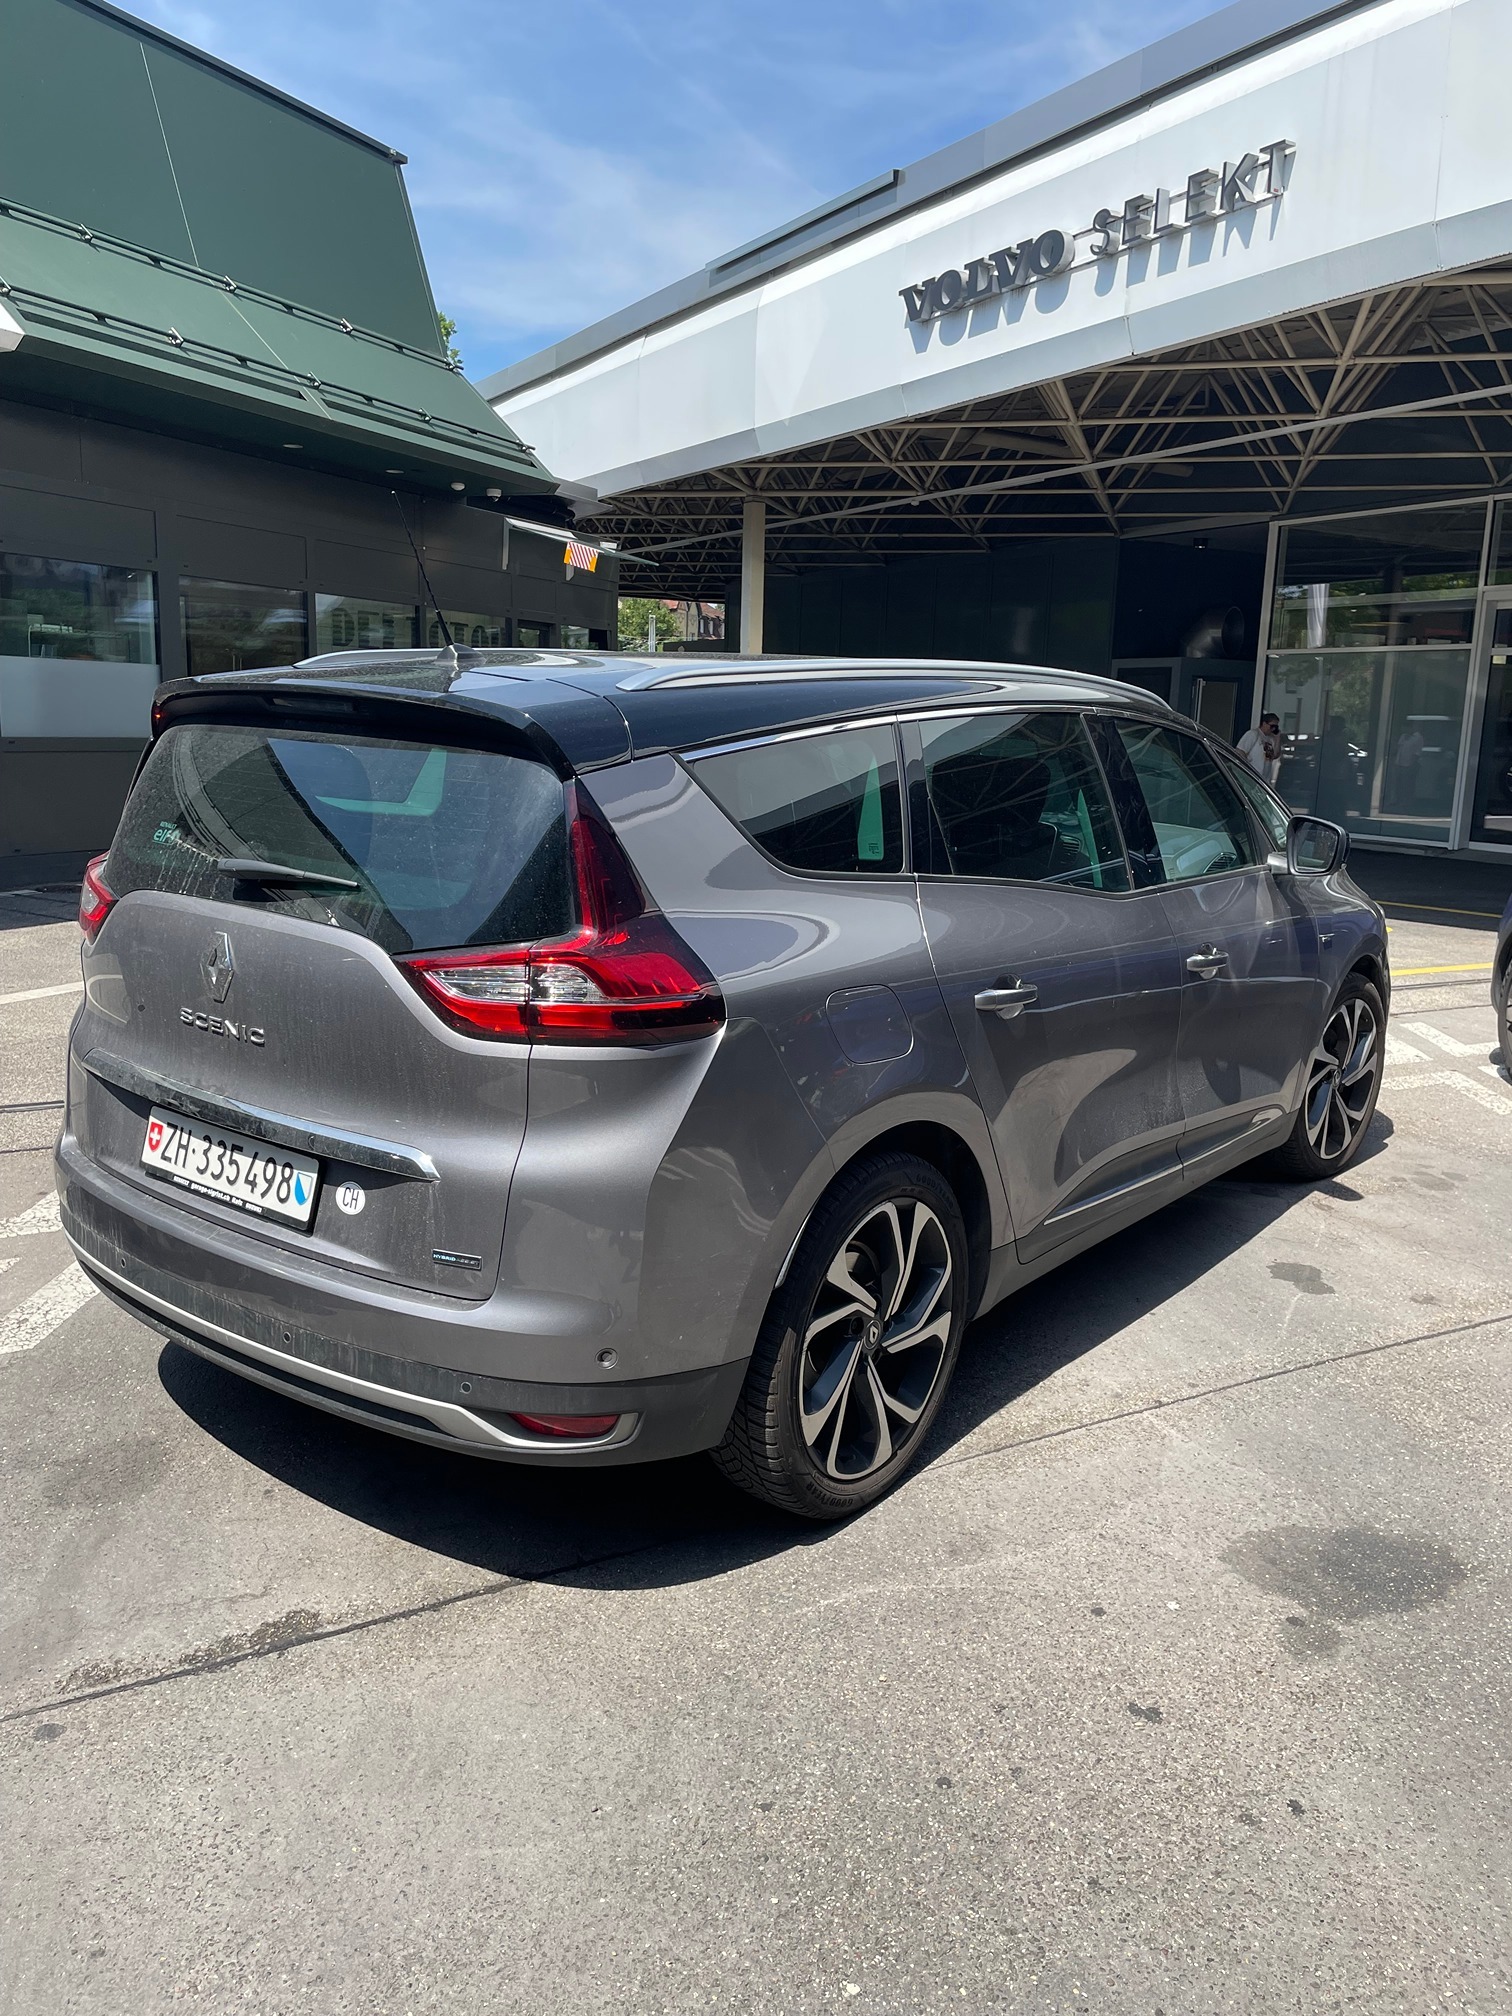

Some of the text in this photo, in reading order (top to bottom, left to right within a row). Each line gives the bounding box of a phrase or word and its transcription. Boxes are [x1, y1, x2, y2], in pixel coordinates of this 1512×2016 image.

[898, 138, 1297, 323] VOLVO SELEKT
[180, 1006, 266, 1048] SCENIC
[342, 1186, 360, 1211] CH
[432, 1253, 457, 1262] HYBRID
